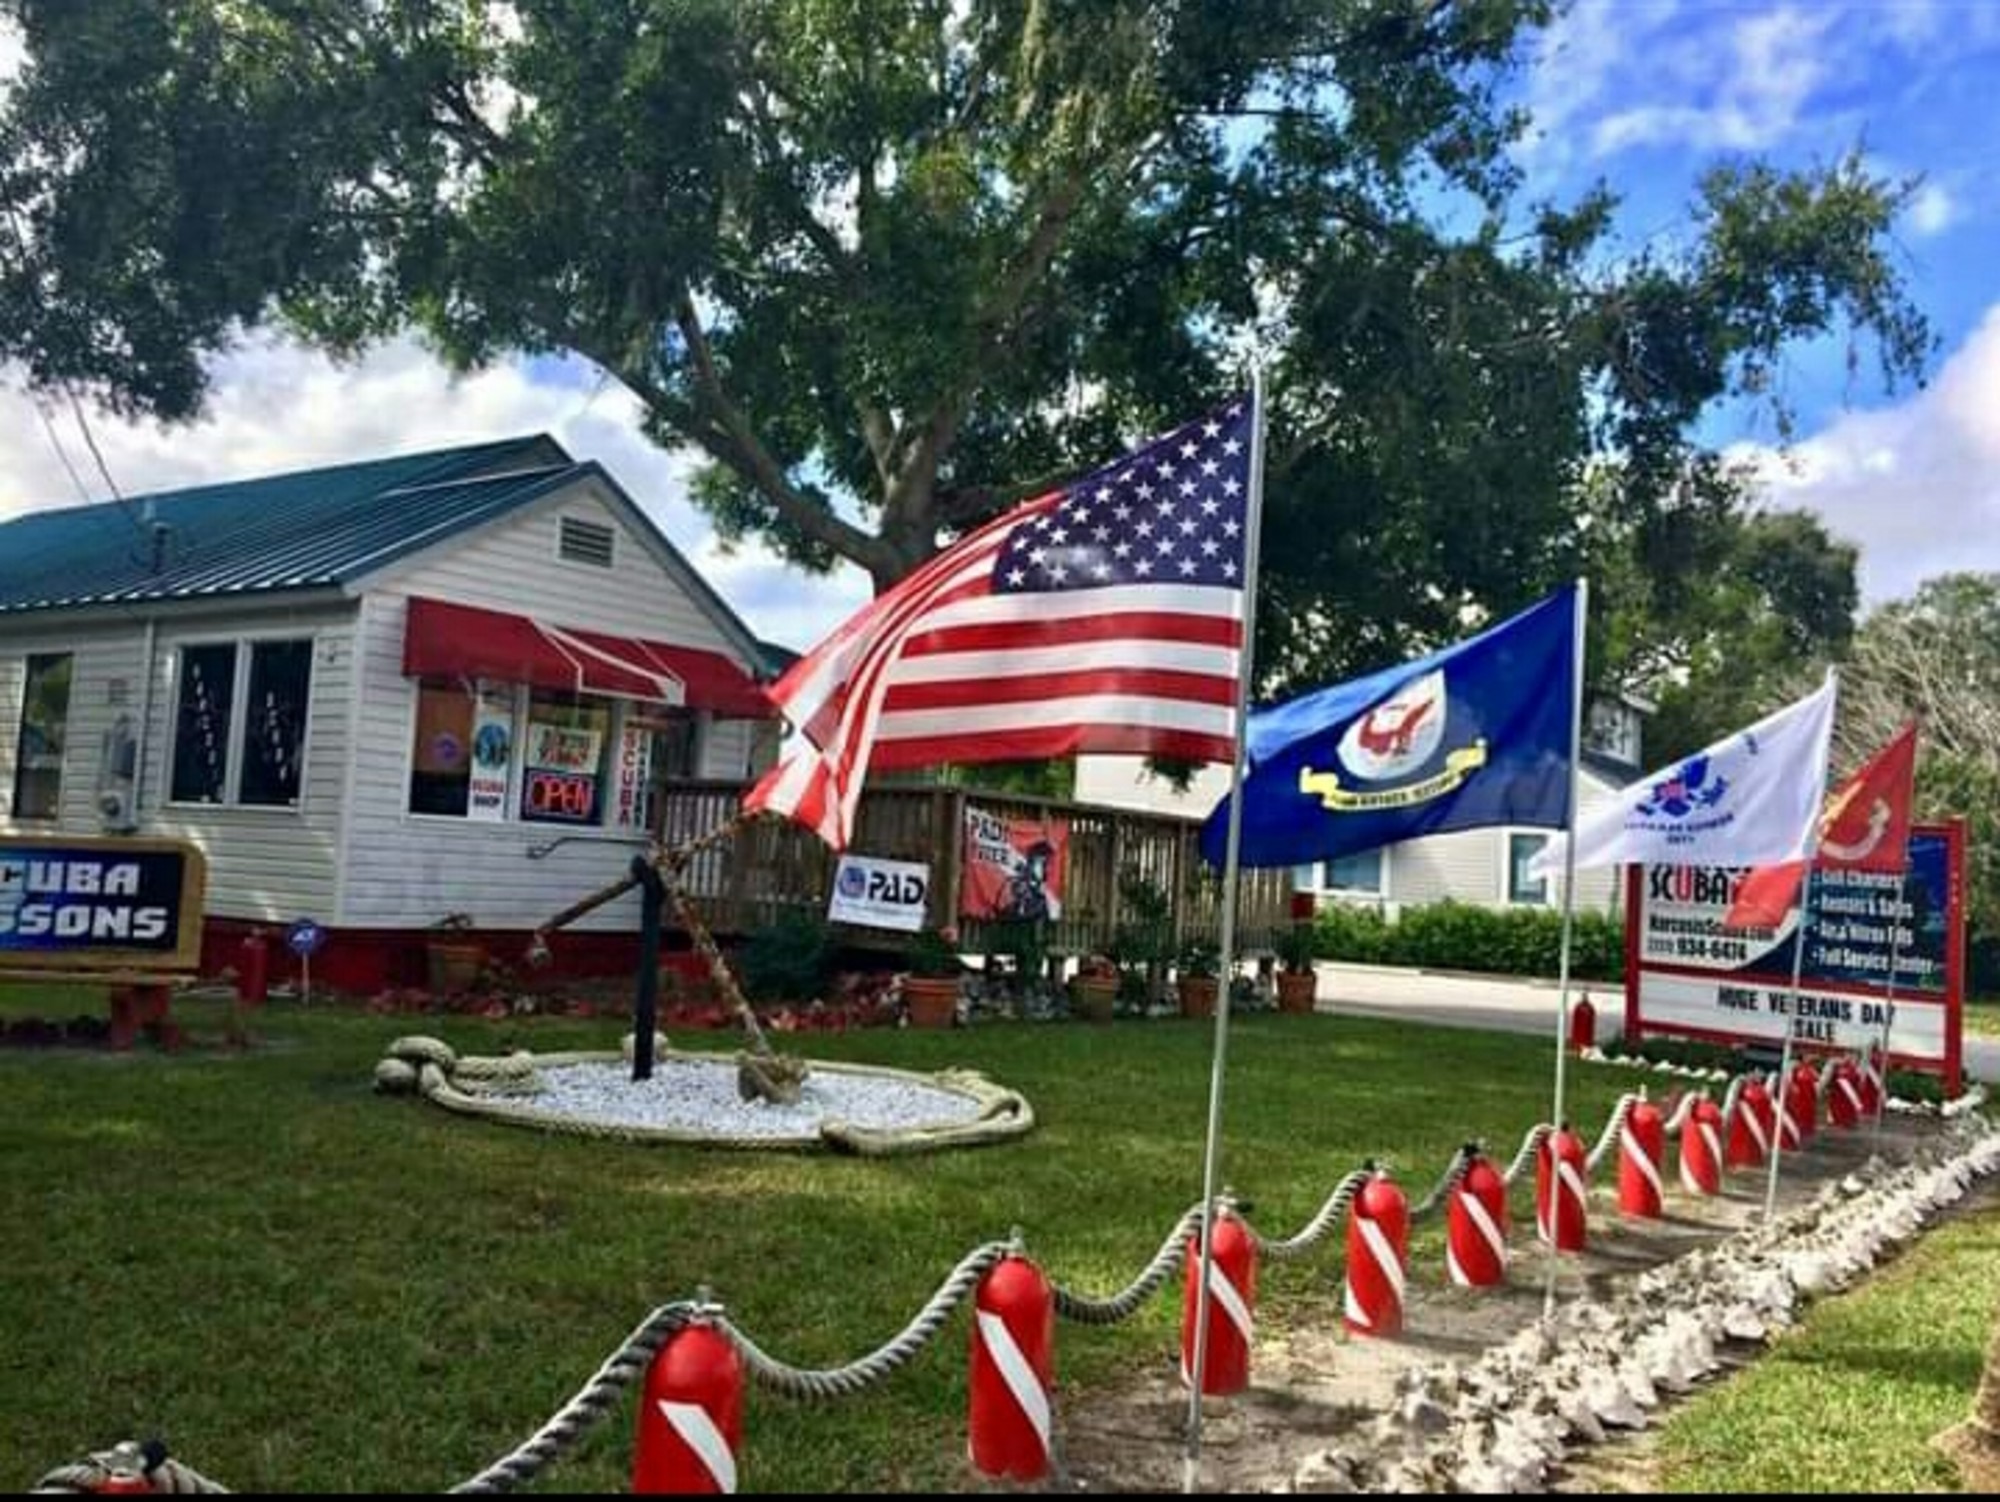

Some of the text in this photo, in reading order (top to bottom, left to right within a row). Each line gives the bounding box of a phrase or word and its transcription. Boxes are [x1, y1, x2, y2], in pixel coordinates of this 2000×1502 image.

[531, 777, 588, 816] OPEN
[618, 732, 636, 825] SCUBA
[0, 859, 140, 896] CUBA
[1719, 985, 1758, 1011] HUGE
[1769, 991, 1852, 1022] VEERANS
[1795, 1018, 1835, 1044] SALE
